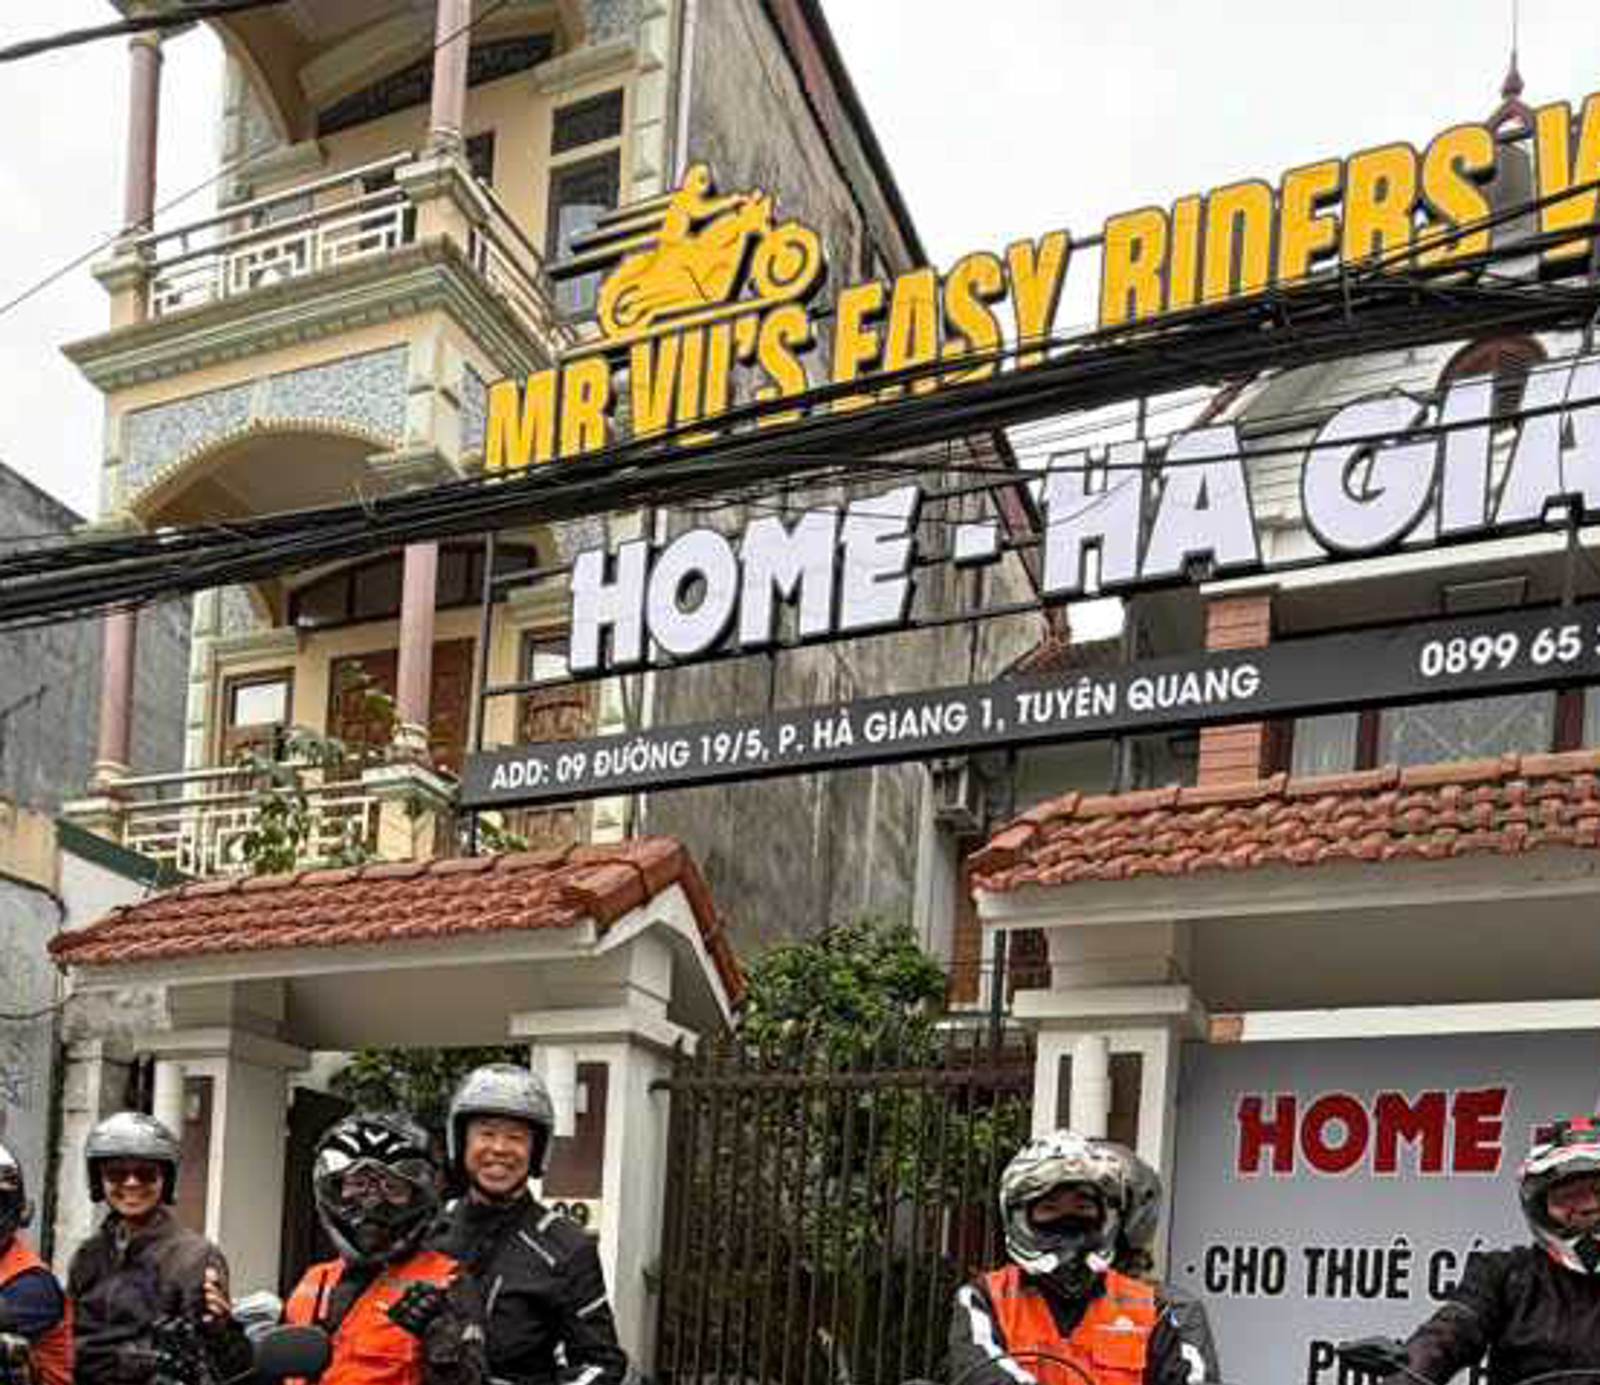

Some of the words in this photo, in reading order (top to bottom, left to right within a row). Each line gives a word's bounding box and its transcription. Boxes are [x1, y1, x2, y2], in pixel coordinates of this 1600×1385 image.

[484, 353, 608, 480] MR
[832, 229, 1068, 411] EASY
[1101, 122, 1494, 326] RIDERS
[568, 485, 921, 673] HOME
[1420, 631, 1520, 677] 0899
[1530, 624, 1583, 665] 65
[491, 759, 551, 790] ADD:
[556, 752, 588, 783] 09
[593, 735, 692, 777] ĐƯỜNG
[700, 719, 769, 765] 19/5,
[779, 723, 804, 755] P.
[813, 708, 854, 749] HÀ
[863, 702, 968, 743] GIANG
[979, 698, 1004, 734] 1,
[1016, 676, 1117, 724] TUYÊN
[1127, 664, 1261, 712] QUANG
[1236, 1085, 1508, 1175] HOME
[1203, 1245, 1288, 1296] CHO
[1303, 1236, 1412, 1300] THUÊ
